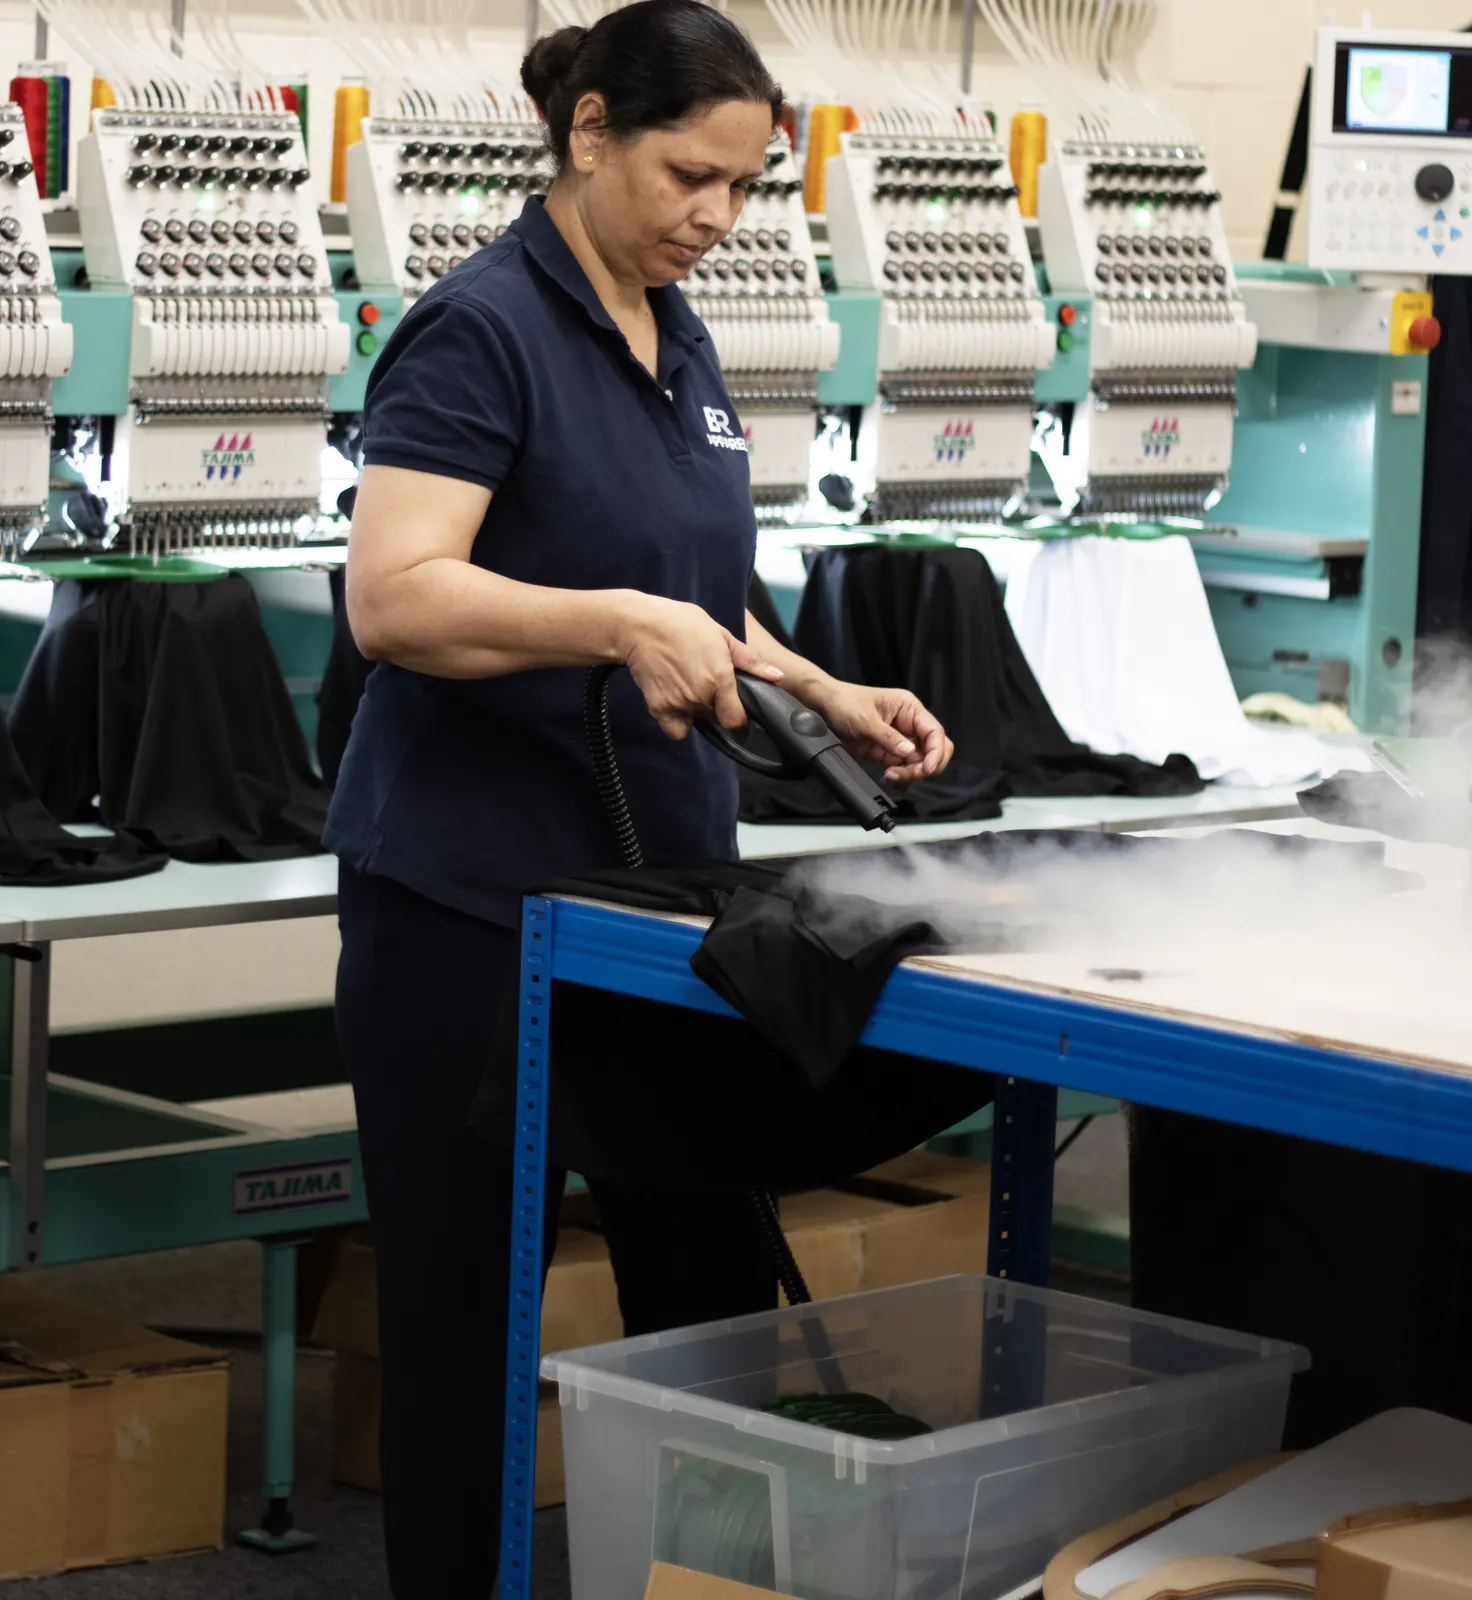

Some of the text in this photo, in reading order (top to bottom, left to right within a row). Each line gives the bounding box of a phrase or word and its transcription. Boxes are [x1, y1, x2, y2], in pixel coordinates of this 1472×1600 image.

[703, 406, 734, 436] BR
[202, 451, 255, 465] TAJIMA
[245, 1171, 342, 1202] TAJIMA
